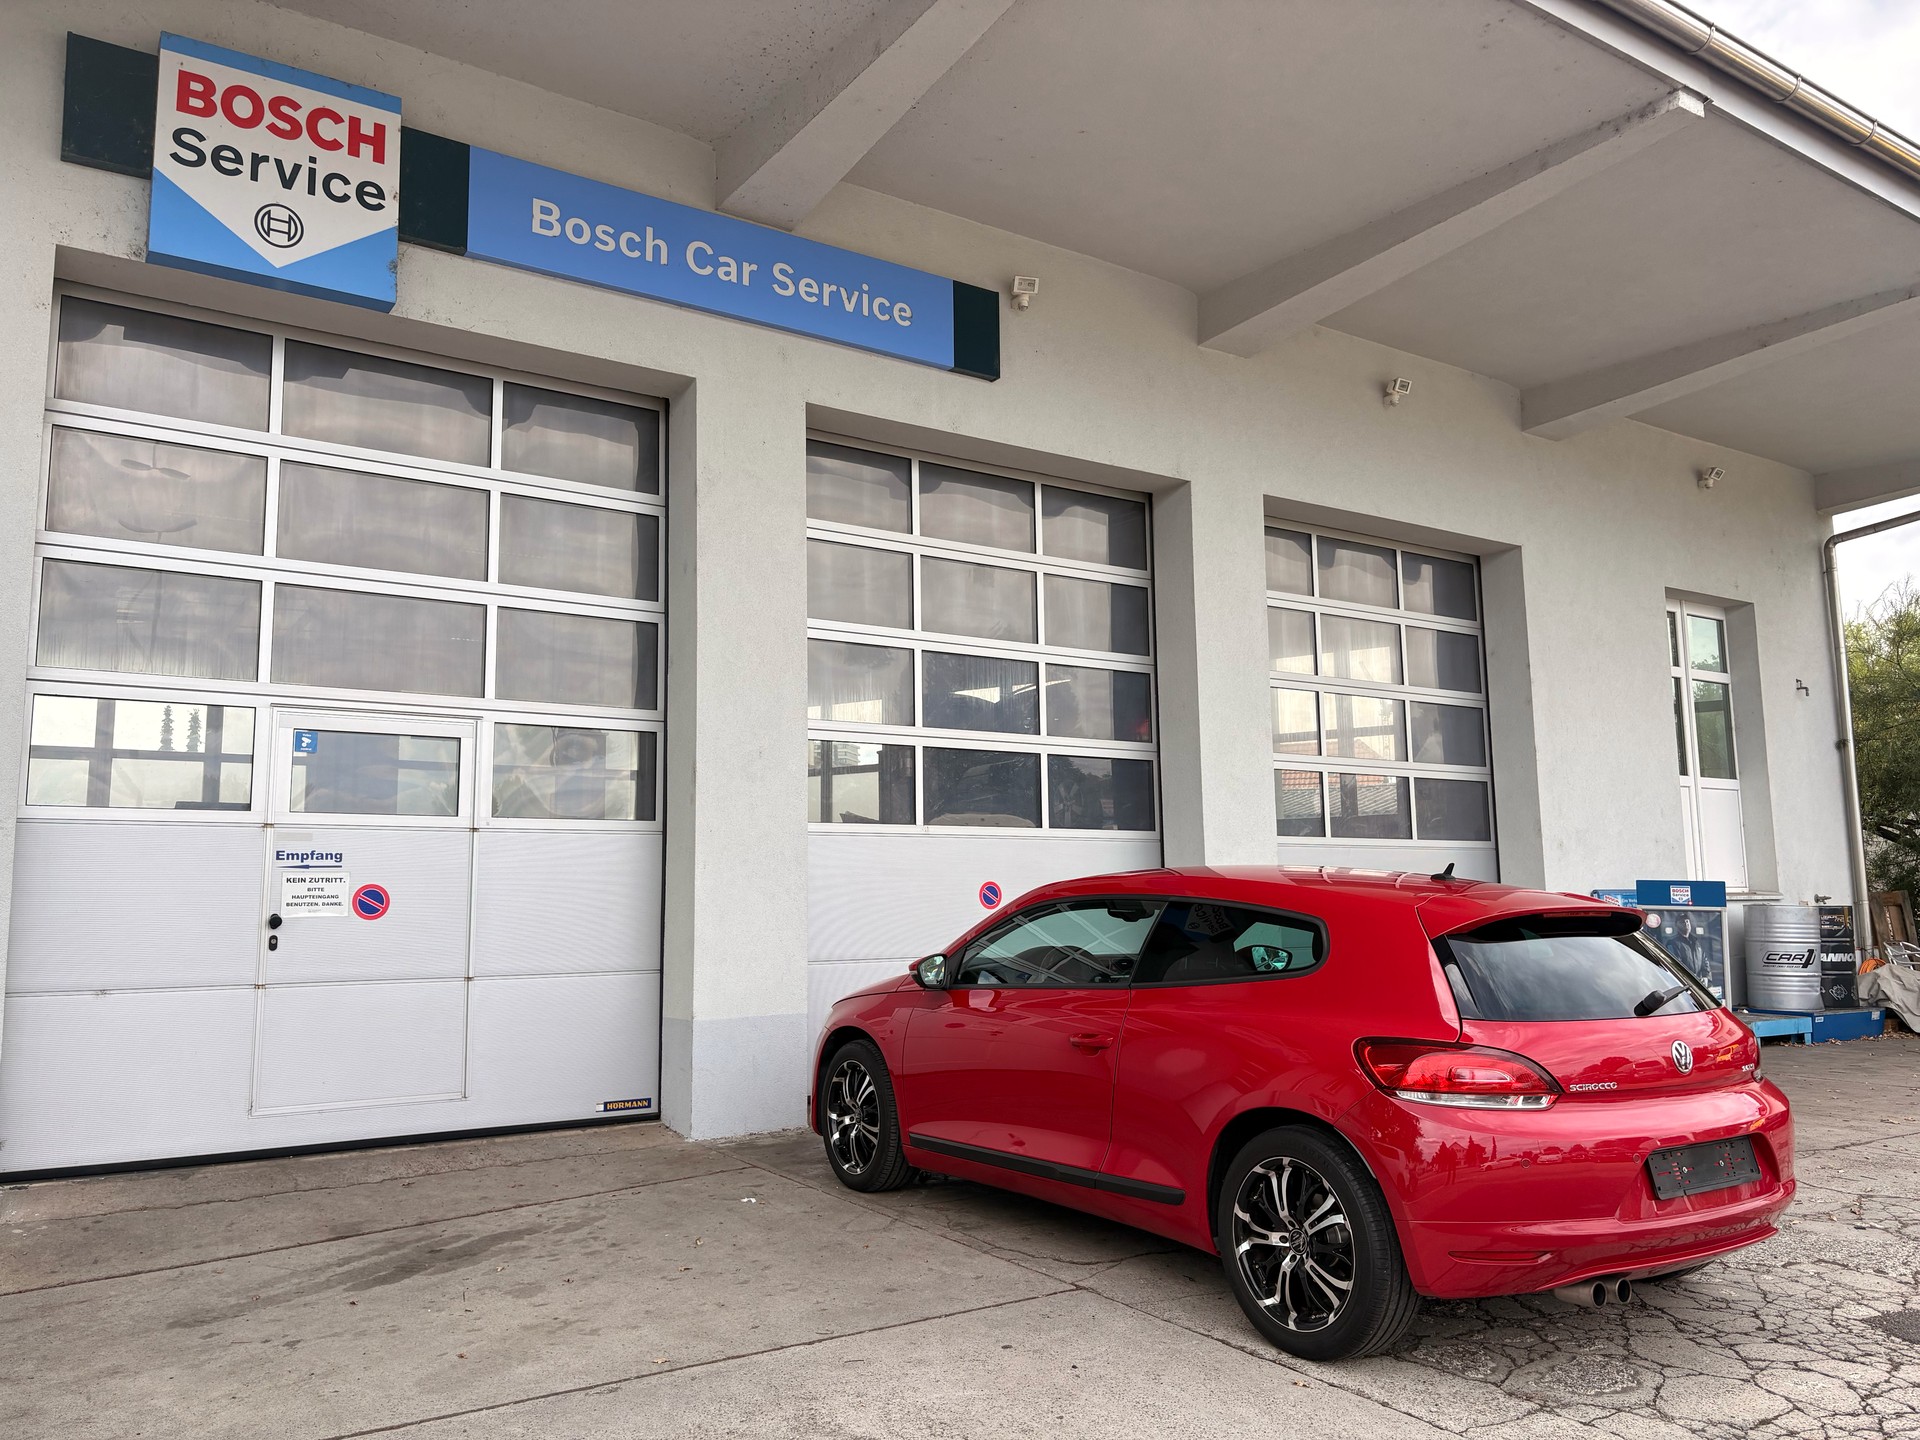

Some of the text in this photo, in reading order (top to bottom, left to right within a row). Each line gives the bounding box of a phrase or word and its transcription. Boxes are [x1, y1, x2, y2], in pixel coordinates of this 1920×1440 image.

[176, 69, 386, 165] BOSCH
[169, 127, 386, 211] Service
[531, 197, 913, 327] Bosch Car Service
[275, 850, 343, 863] Empfang
[1569, 1082, 1618, 1092] SCIROCCO
